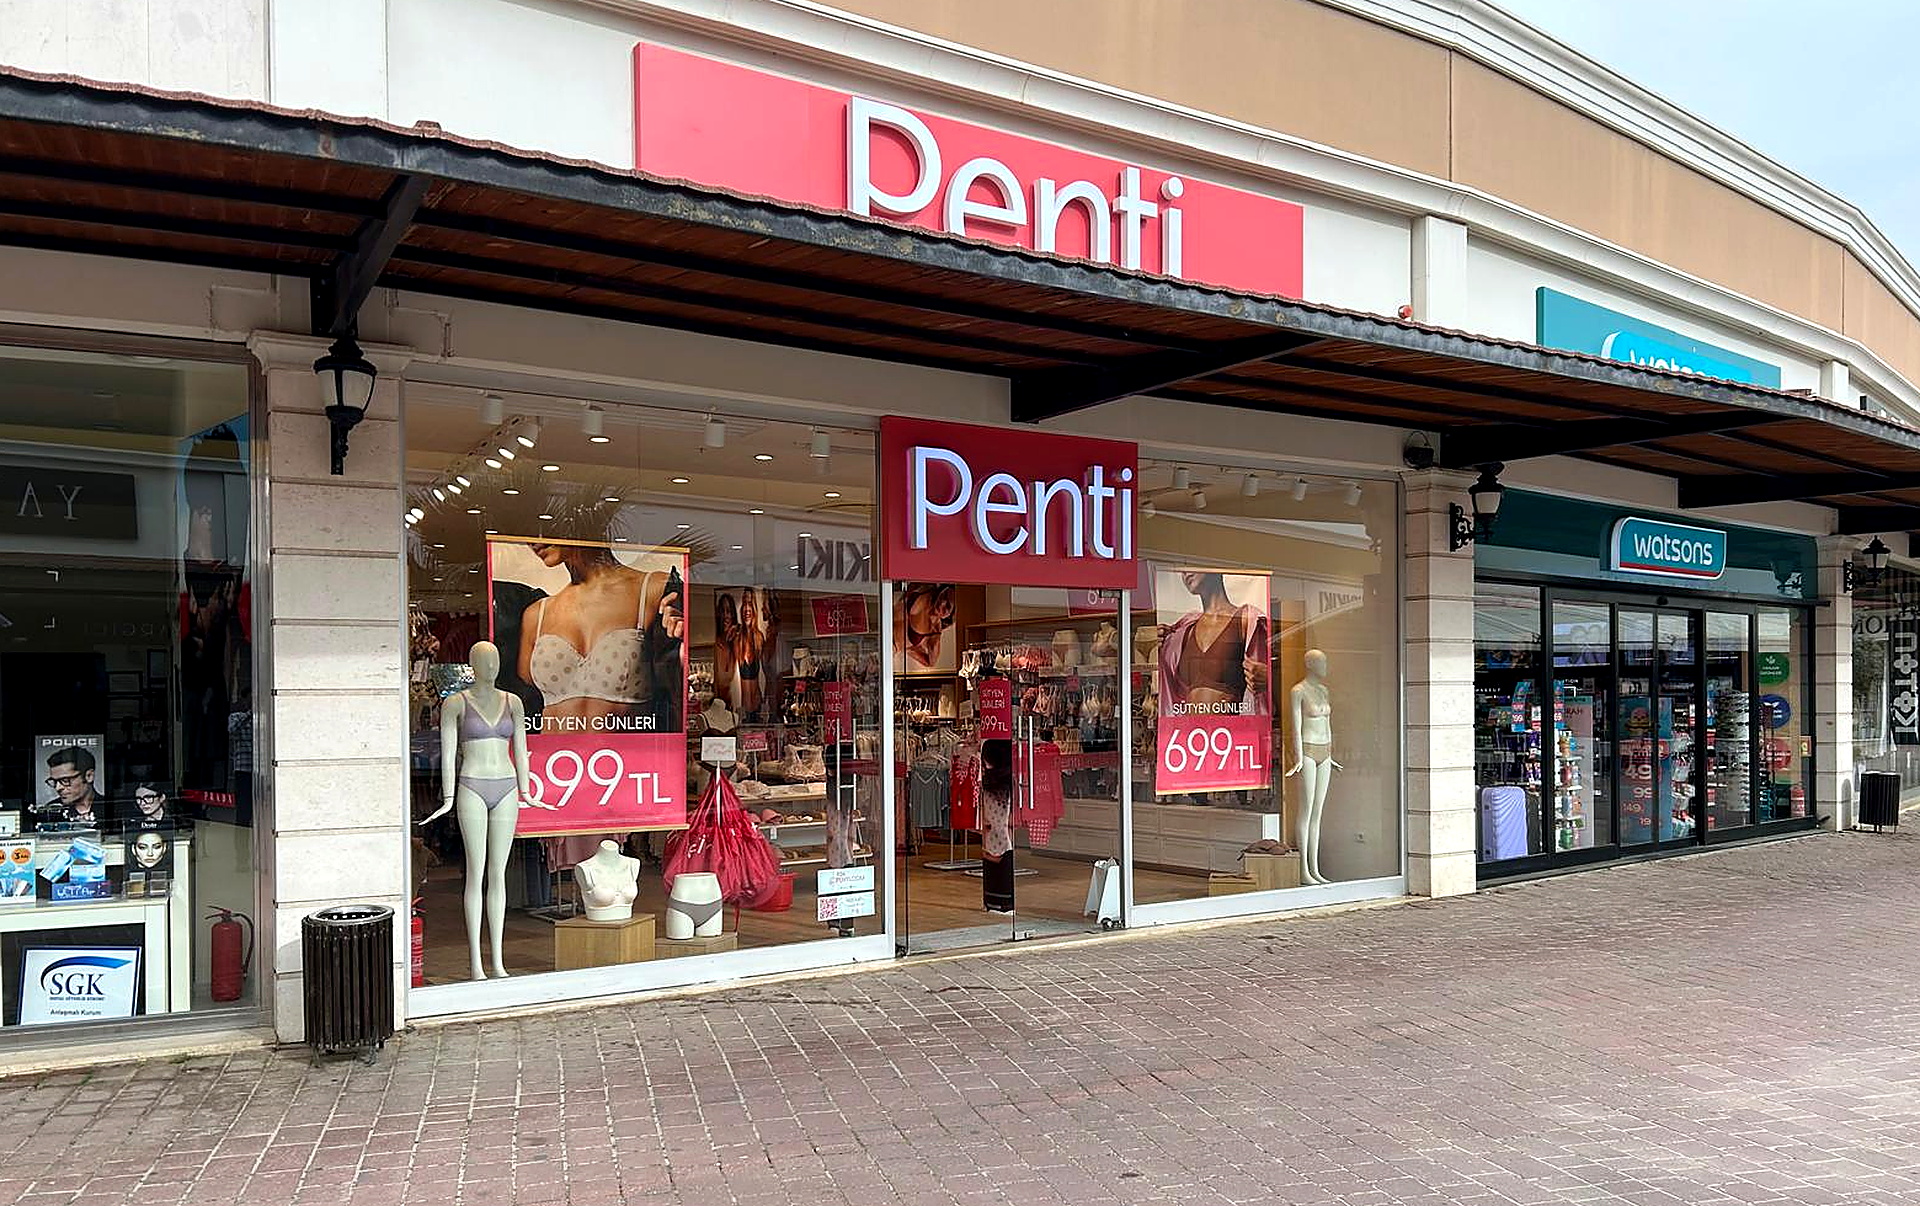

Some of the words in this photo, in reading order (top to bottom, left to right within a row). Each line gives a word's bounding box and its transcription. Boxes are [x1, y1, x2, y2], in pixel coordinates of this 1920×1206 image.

[847, 96, 1185, 278] Penti
[909, 446, 1133, 560] Penti
[1633, 532, 1713, 566] watsons
[1173, 700, 1211, 715] SÜTYEN
[1212, 699, 1252, 714] GÜNLERİ
[525, 713, 586, 731] SÜTYEN
[591, 712, 656, 730] GÜNLERİ
[42, 738, 98, 747] POLICE
[49, 973, 105, 996] SGK
